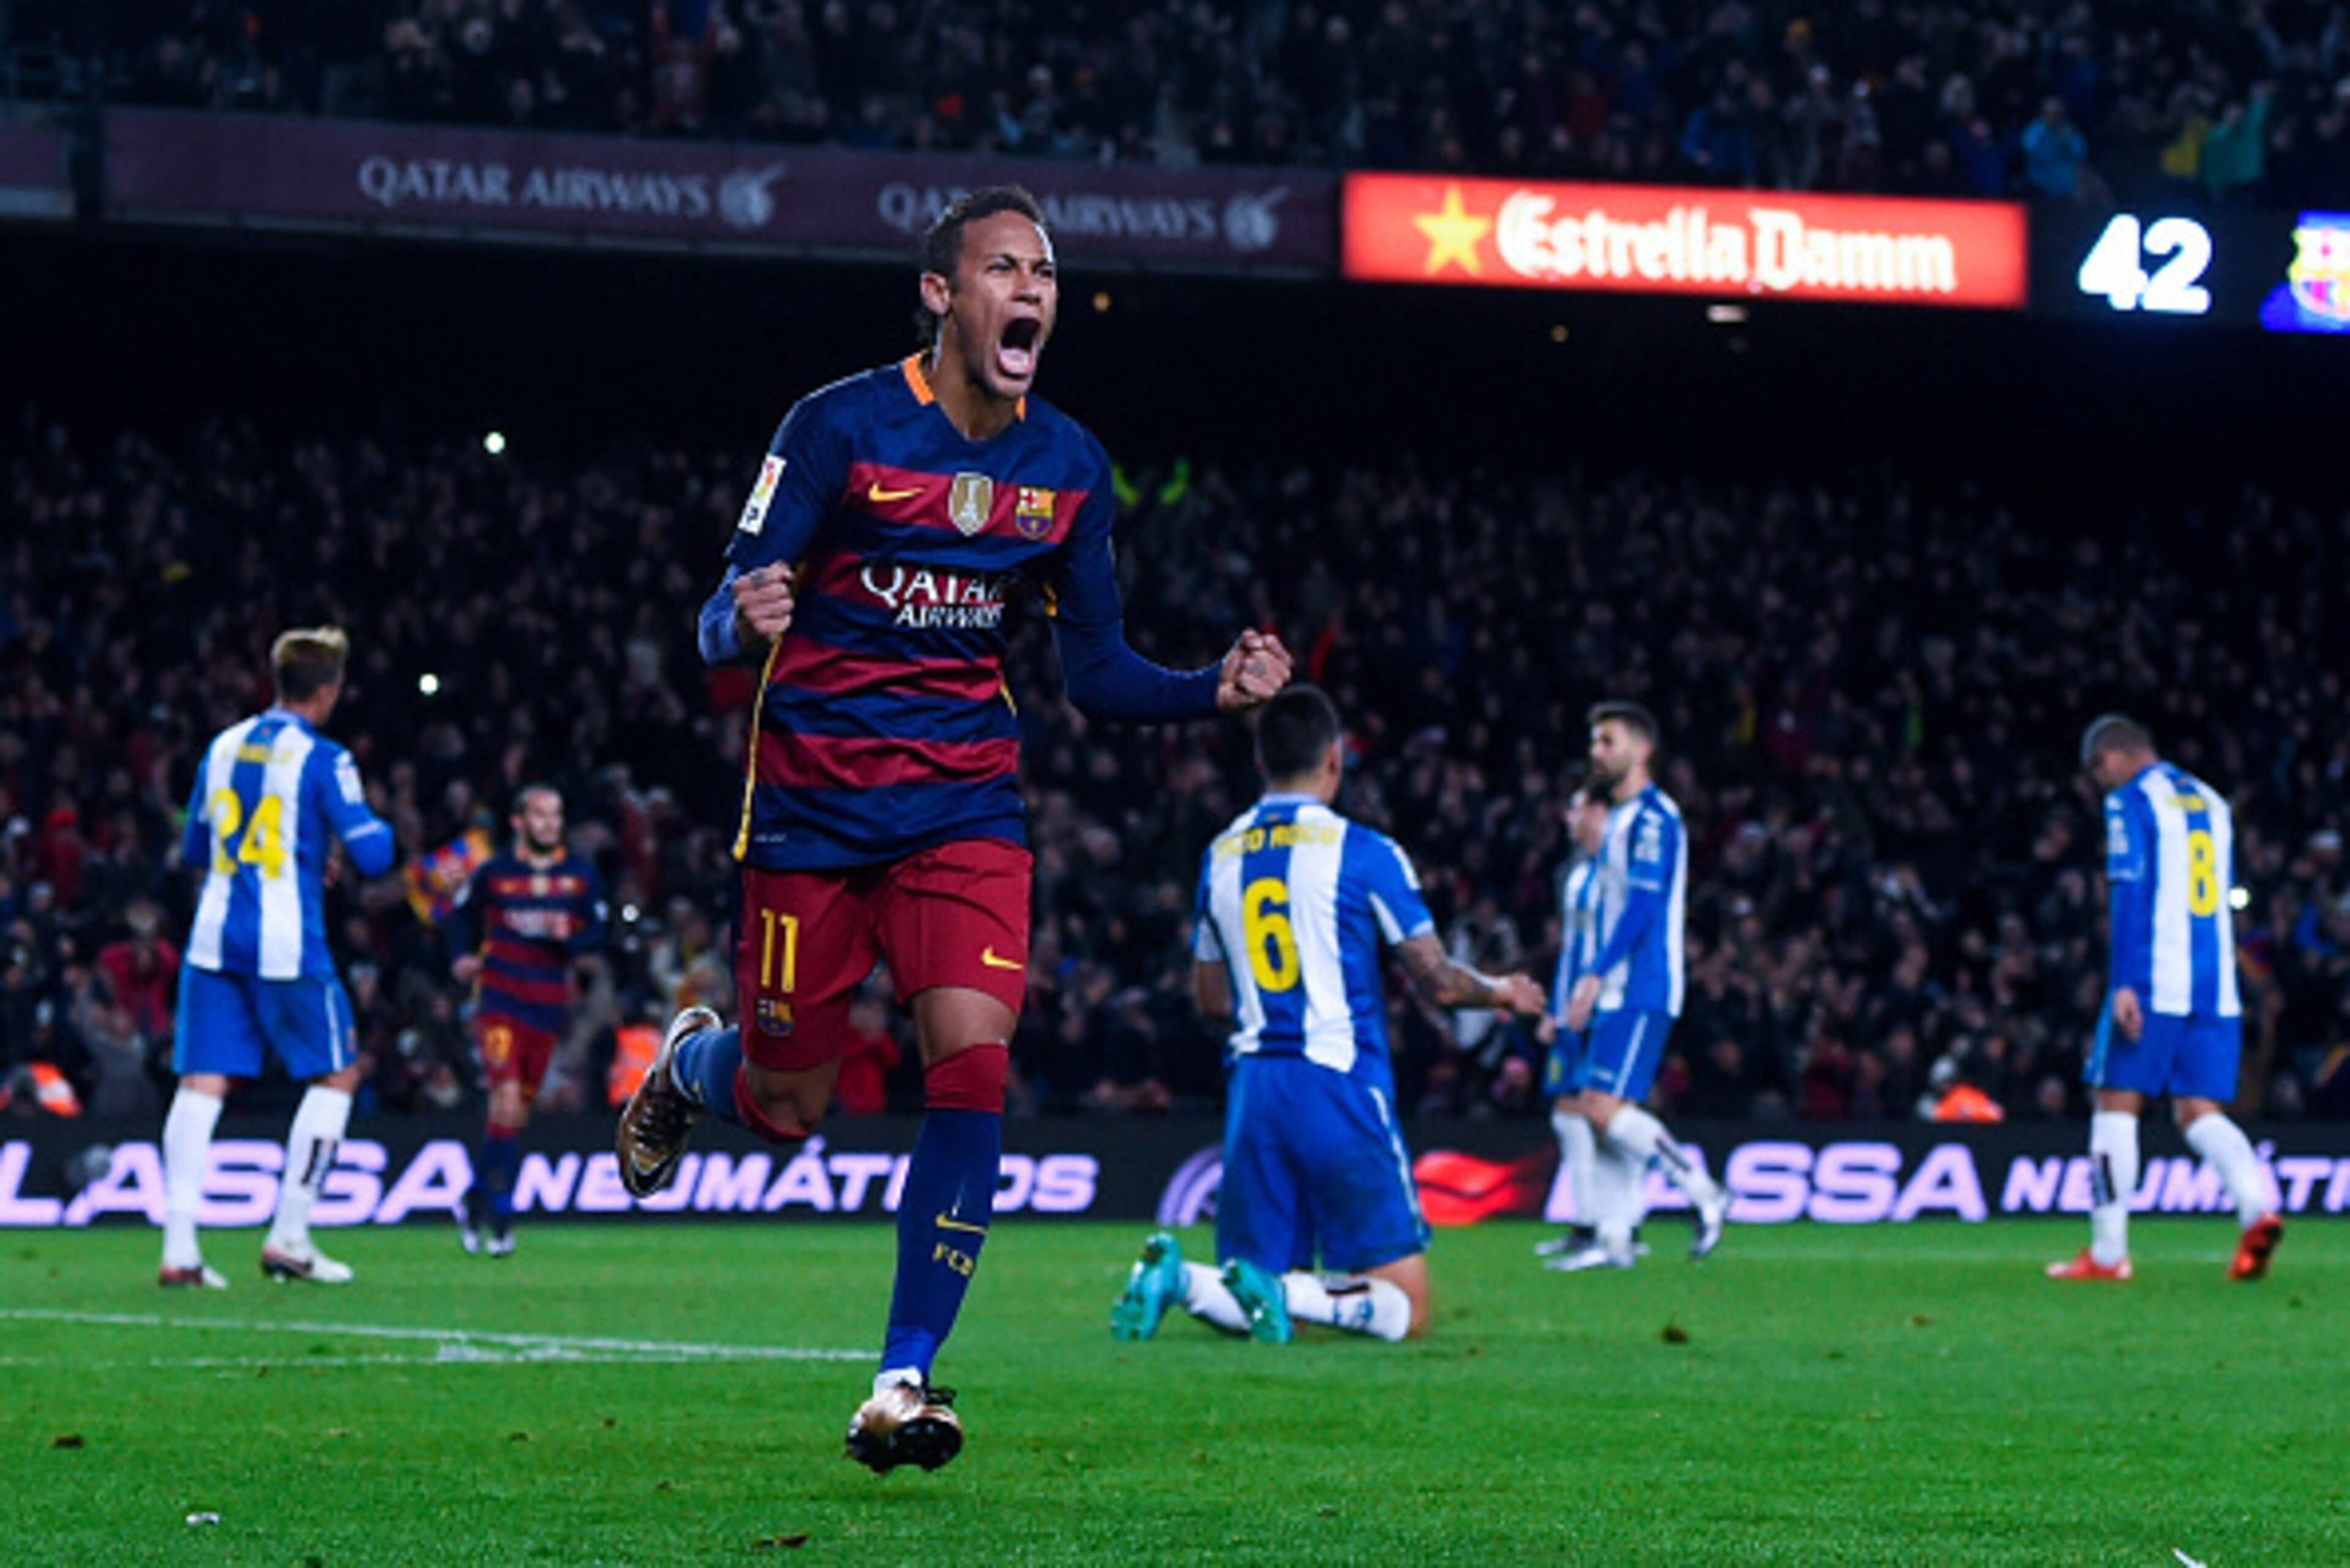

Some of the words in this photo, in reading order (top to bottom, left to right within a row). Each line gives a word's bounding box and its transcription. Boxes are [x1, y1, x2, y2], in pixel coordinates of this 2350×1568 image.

[357, 156, 509, 207] QATAR
[521, 166, 710, 218] AIRWAYS
[1496, 190, 1748, 282] Estrella
[1747, 207, 1957, 294] Damm
[2078, 212, 2212, 315] 42
[210, 787, 286, 880] 24
[2188, 828, 2220, 917] 8
[761, 908, 799, 994] 11
[1242, 876, 1300, 993] 6
[0, 1140, 474, 1226] LASSA
[510, 1137, 1100, 1213] NEUMÁTIOS
